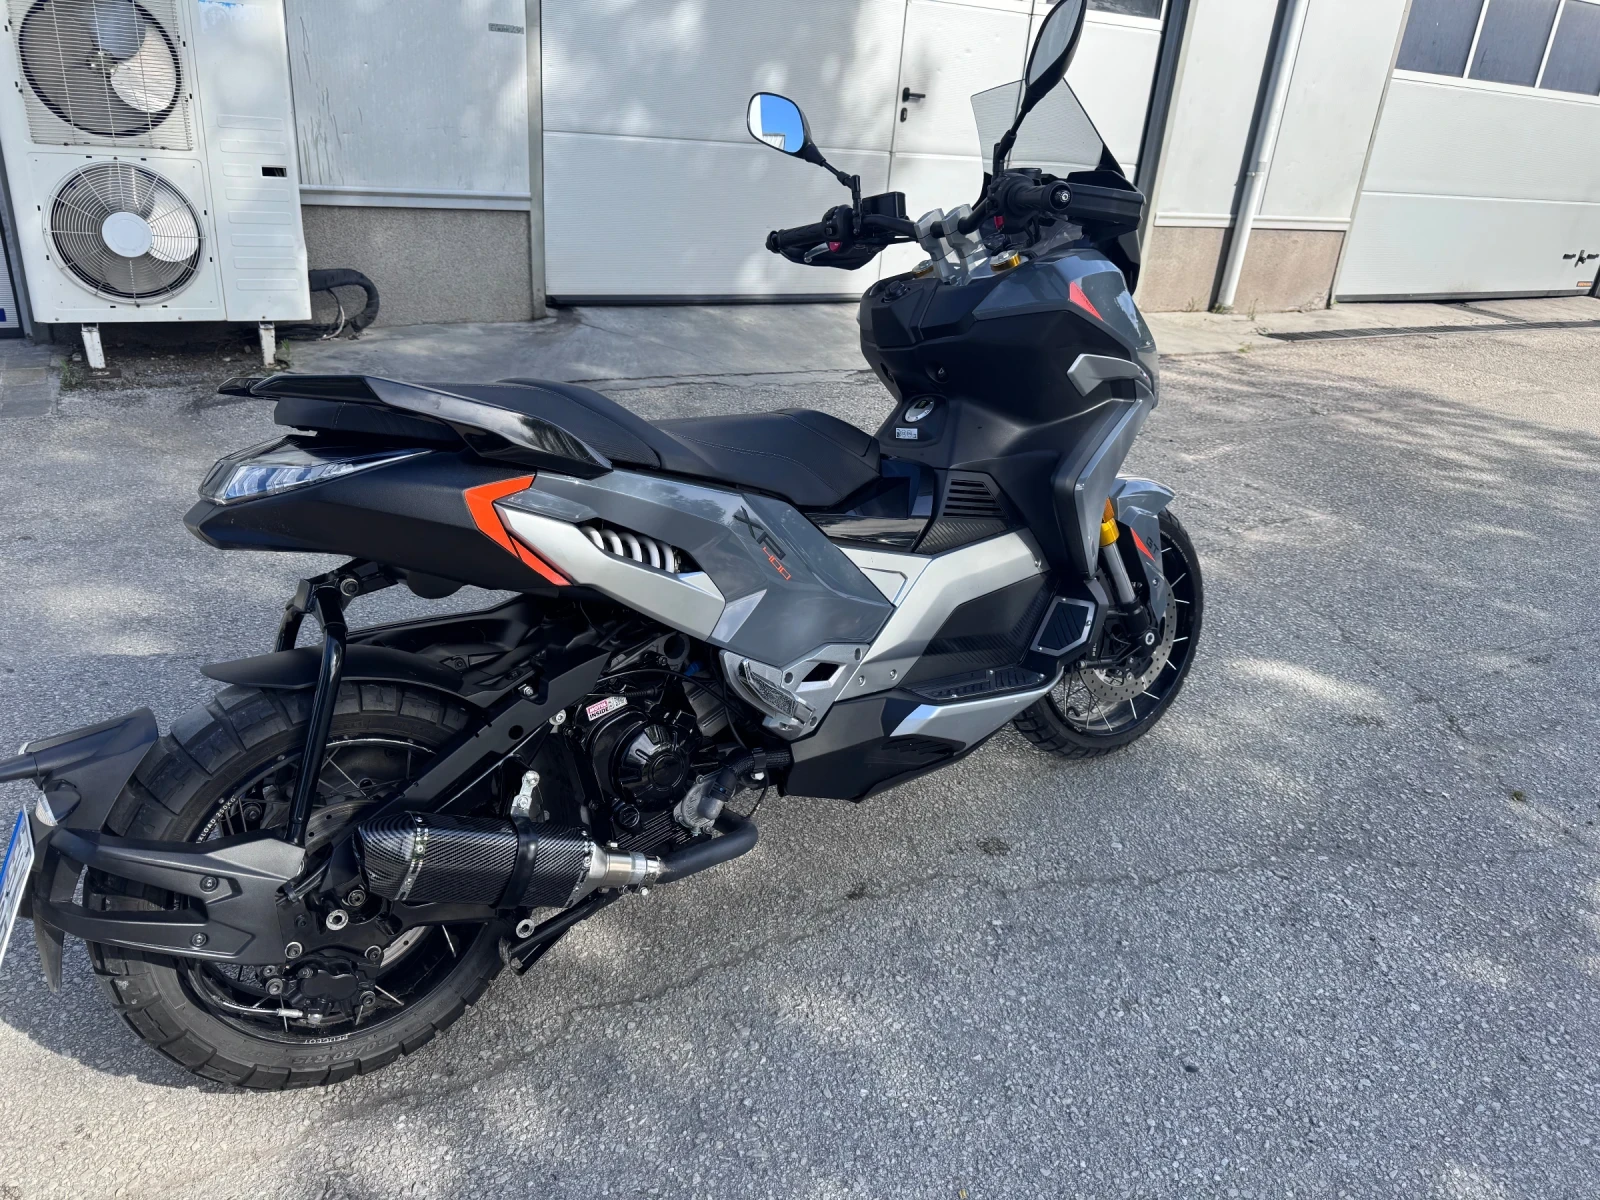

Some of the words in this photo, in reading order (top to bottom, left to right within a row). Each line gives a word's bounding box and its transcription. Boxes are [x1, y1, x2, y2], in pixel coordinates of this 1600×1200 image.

[732, 505, 786, 560] XP
[1146, 536, 1159, 554] GT
[589, 702, 607, 713] MOTUL
[590, 707, 609, 718] INSIDE
